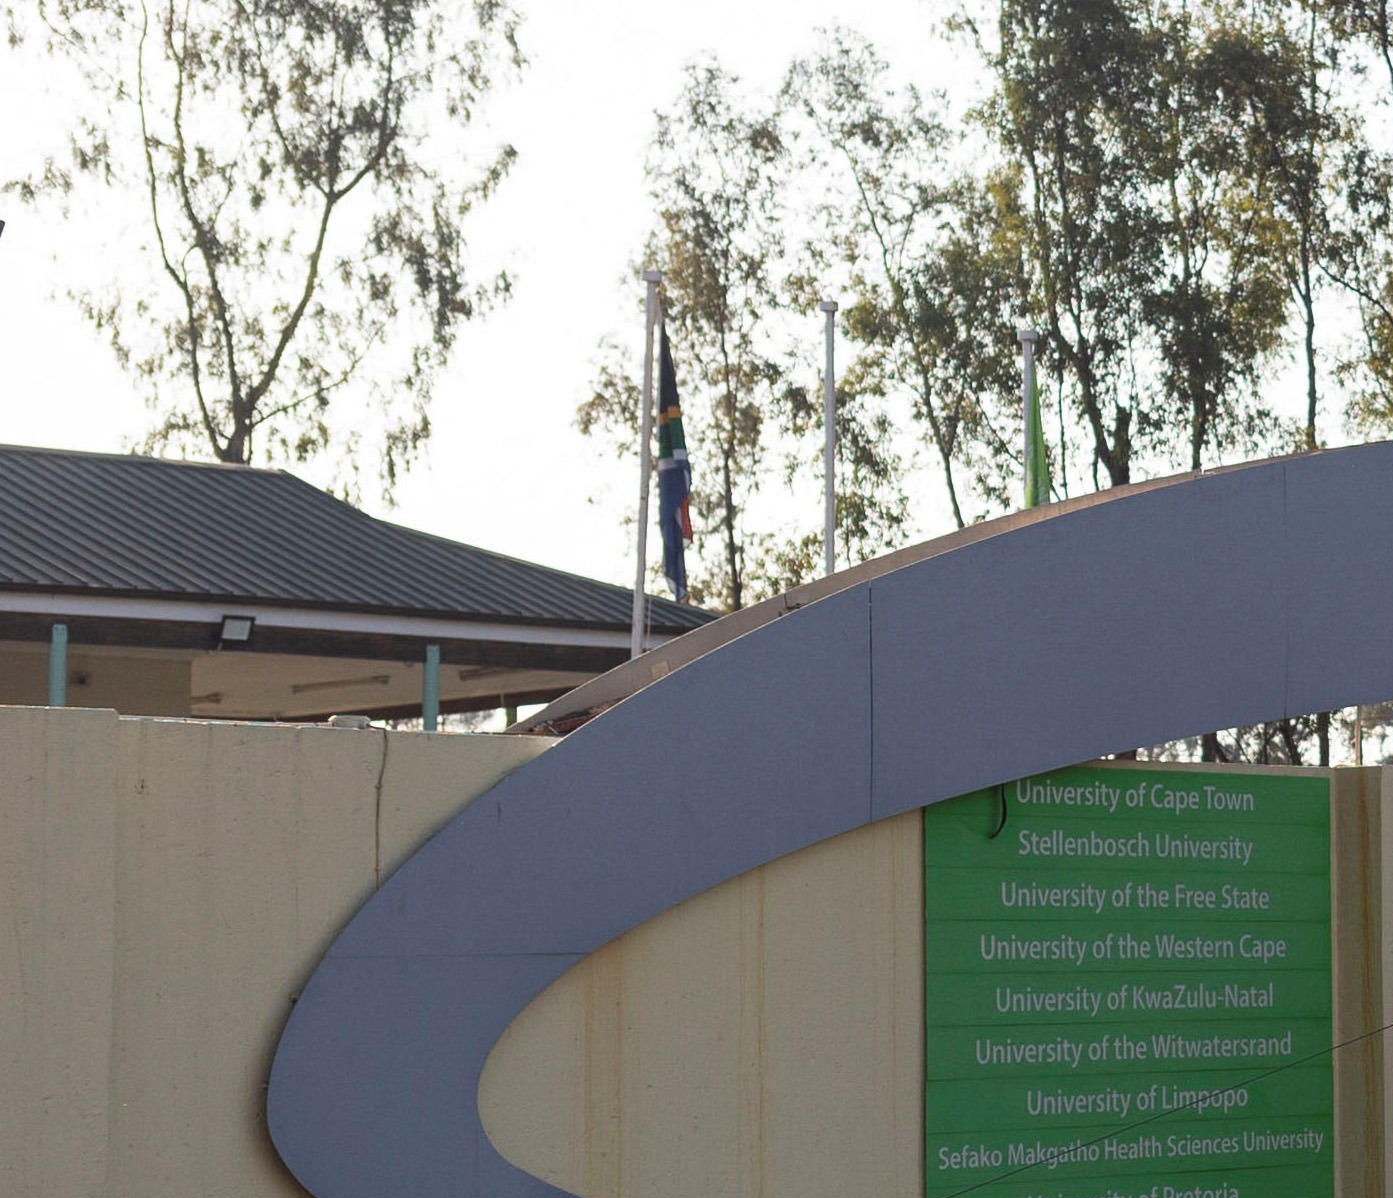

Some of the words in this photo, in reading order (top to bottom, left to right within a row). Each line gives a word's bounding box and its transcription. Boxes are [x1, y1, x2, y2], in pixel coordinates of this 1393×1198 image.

[1016, 779, 1119, 812] University
[1126, 782, 1146, 807] of
[1151, 784, 1199, 813] Cape
[1204, 786, 1254, 810] Town
[1019, 831, 1149, 857] Stellenbosch
[1156, 834, 1252, 865] University
[1001, 882, 1106, 913] University
[1111, 883, 1131, 907] of
[1137, 883, 1169, 907] the
[1175, 884, 1216, 908] Free
[1222, 885, 1269, 909] State
[980, 935, 1087, 965] University
[1093, 933, 1113, 959] of
[1118, 934, 1151, 958] the
[1155, 935, 1233, 958] Western
[1239, 934, 1286, 963] Cape
[996, 987, 1101, 1017] University
[1107, 985, 1128, 1010] of
[1133, 983, 1273, 1009] KwaZulu-Natal
[976, 1038, 1083, 1068] University
[1088, 1035, 1109, 1060] of
[1114, 1035, 1147, 1059] the
[1152, 1032, 1291, 1058] Witwatersrand
[1027, 1089, 1131, 1118] University
[1137, 1087, 1157, 1111] of
[1162, 1086, 1248, 1114] Limpopo
[939, 1145, 1002, 1170] Sefako
[1008, 1140, 1099, 1169] Makgatho
[1104, 1137, 1162, 1160] Health
[1167, 1135, 1239, 1157] Sciences
[1243, 1128, 1323, 1152] University
